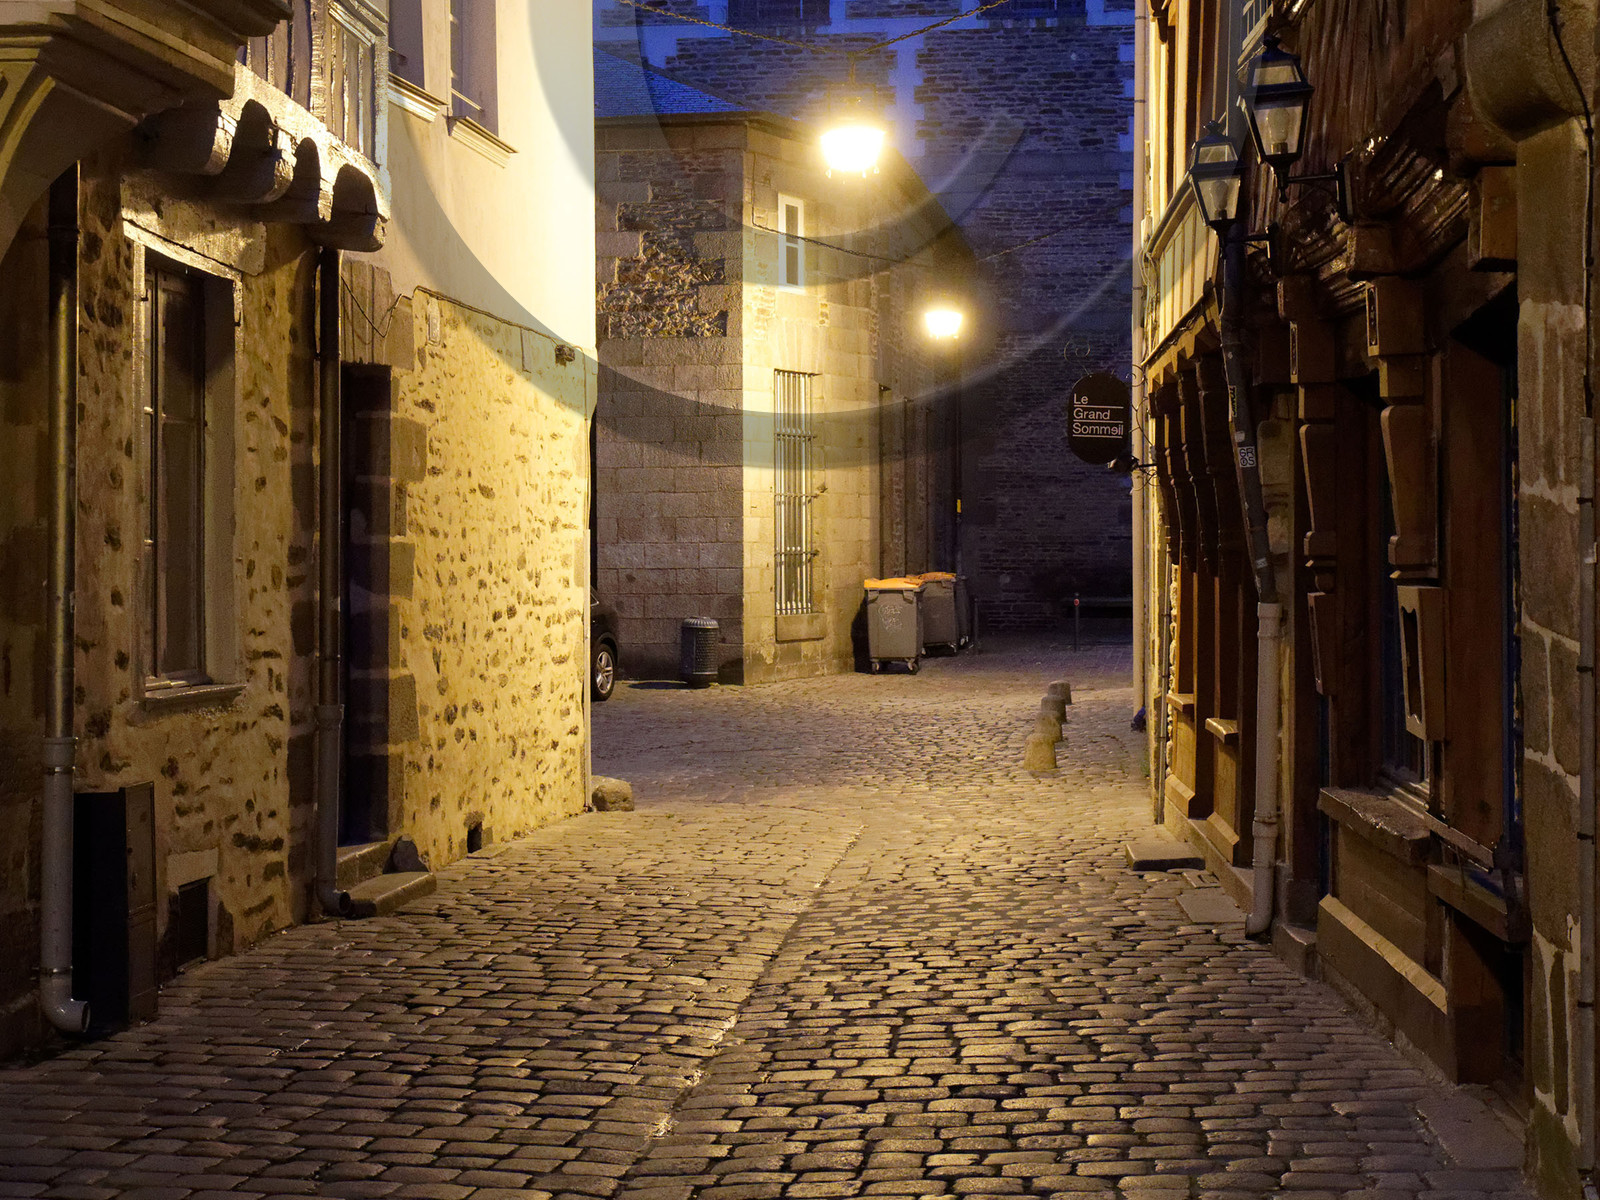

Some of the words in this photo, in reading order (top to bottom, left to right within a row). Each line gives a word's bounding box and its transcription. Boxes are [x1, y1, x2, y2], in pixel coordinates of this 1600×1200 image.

[1073, 393, 1089, 405] Le
[1073, 407, 1111, 420] Grand
[1072, 422, 1124, 436] Sommeil
